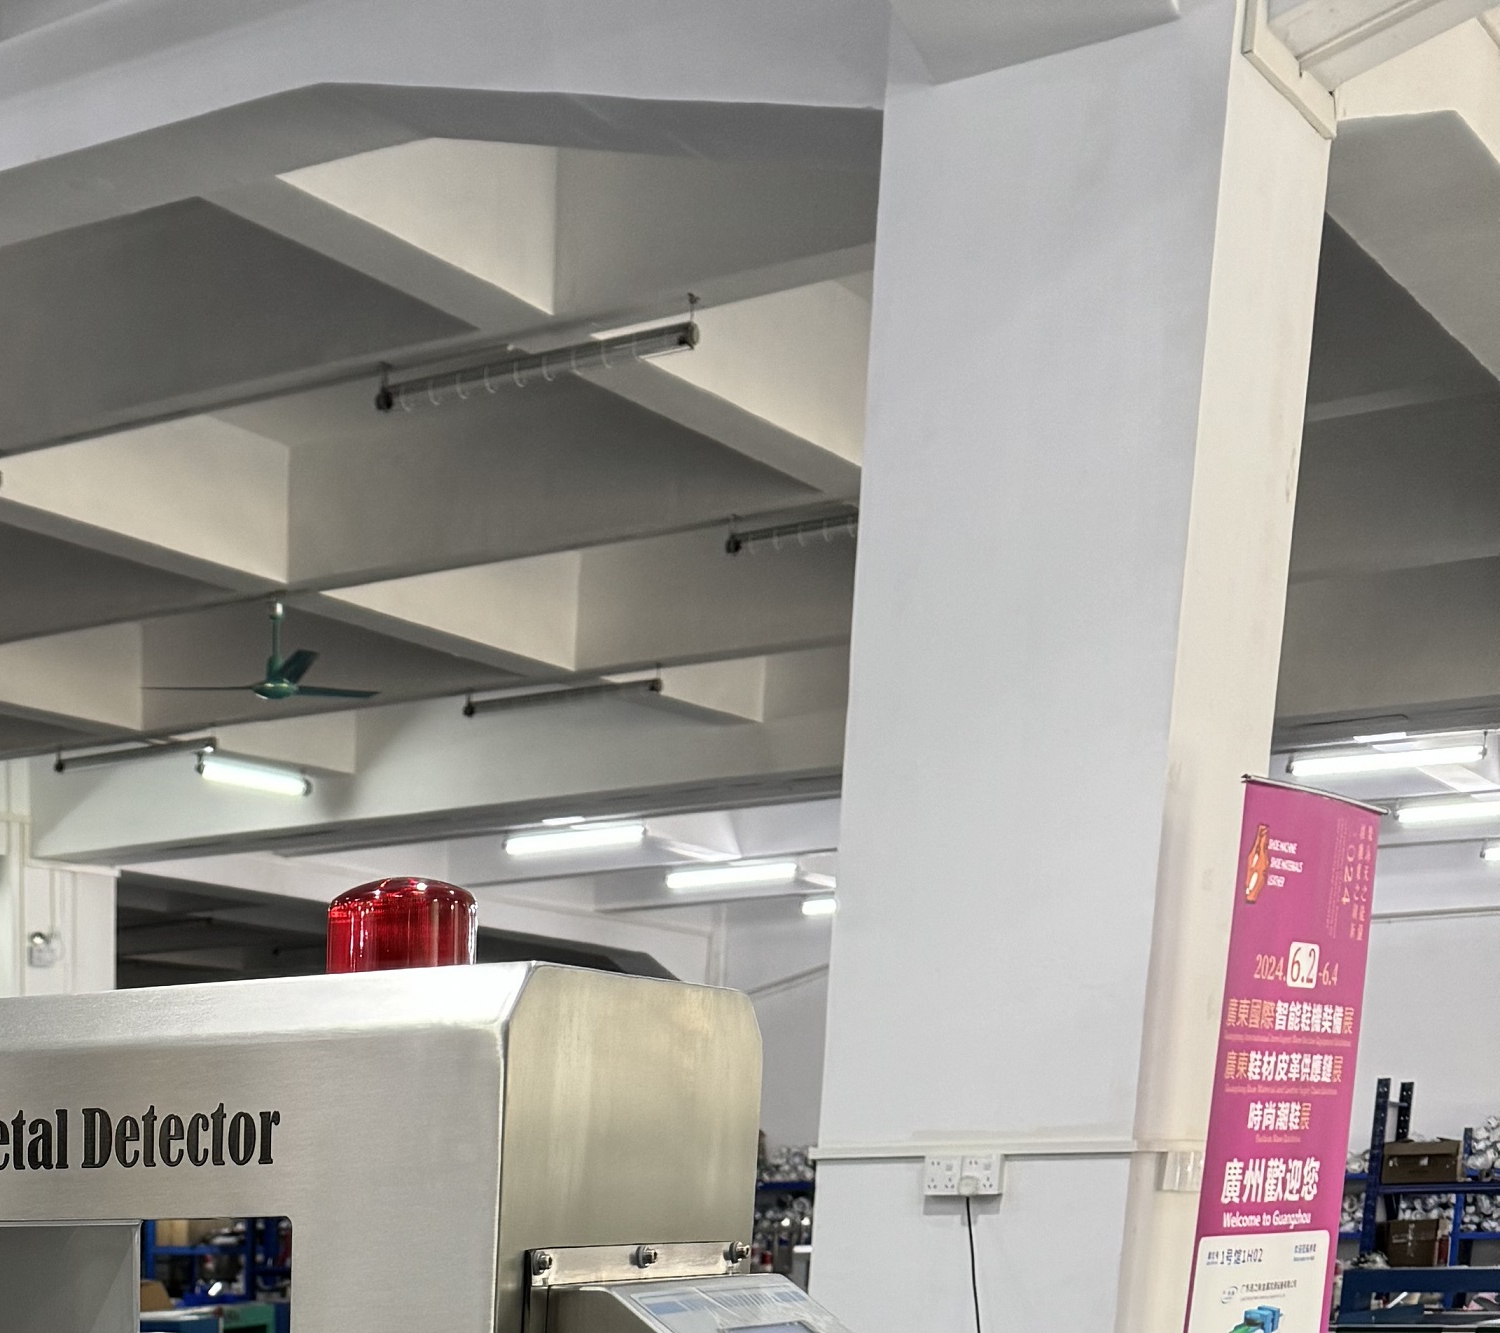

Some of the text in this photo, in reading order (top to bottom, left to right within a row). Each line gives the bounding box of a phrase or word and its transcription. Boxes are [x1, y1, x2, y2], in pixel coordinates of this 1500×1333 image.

[81, 1103, 281, 1169] Detector
[1223, 1208, 1311, 1229] Welcome to Guangzhou
